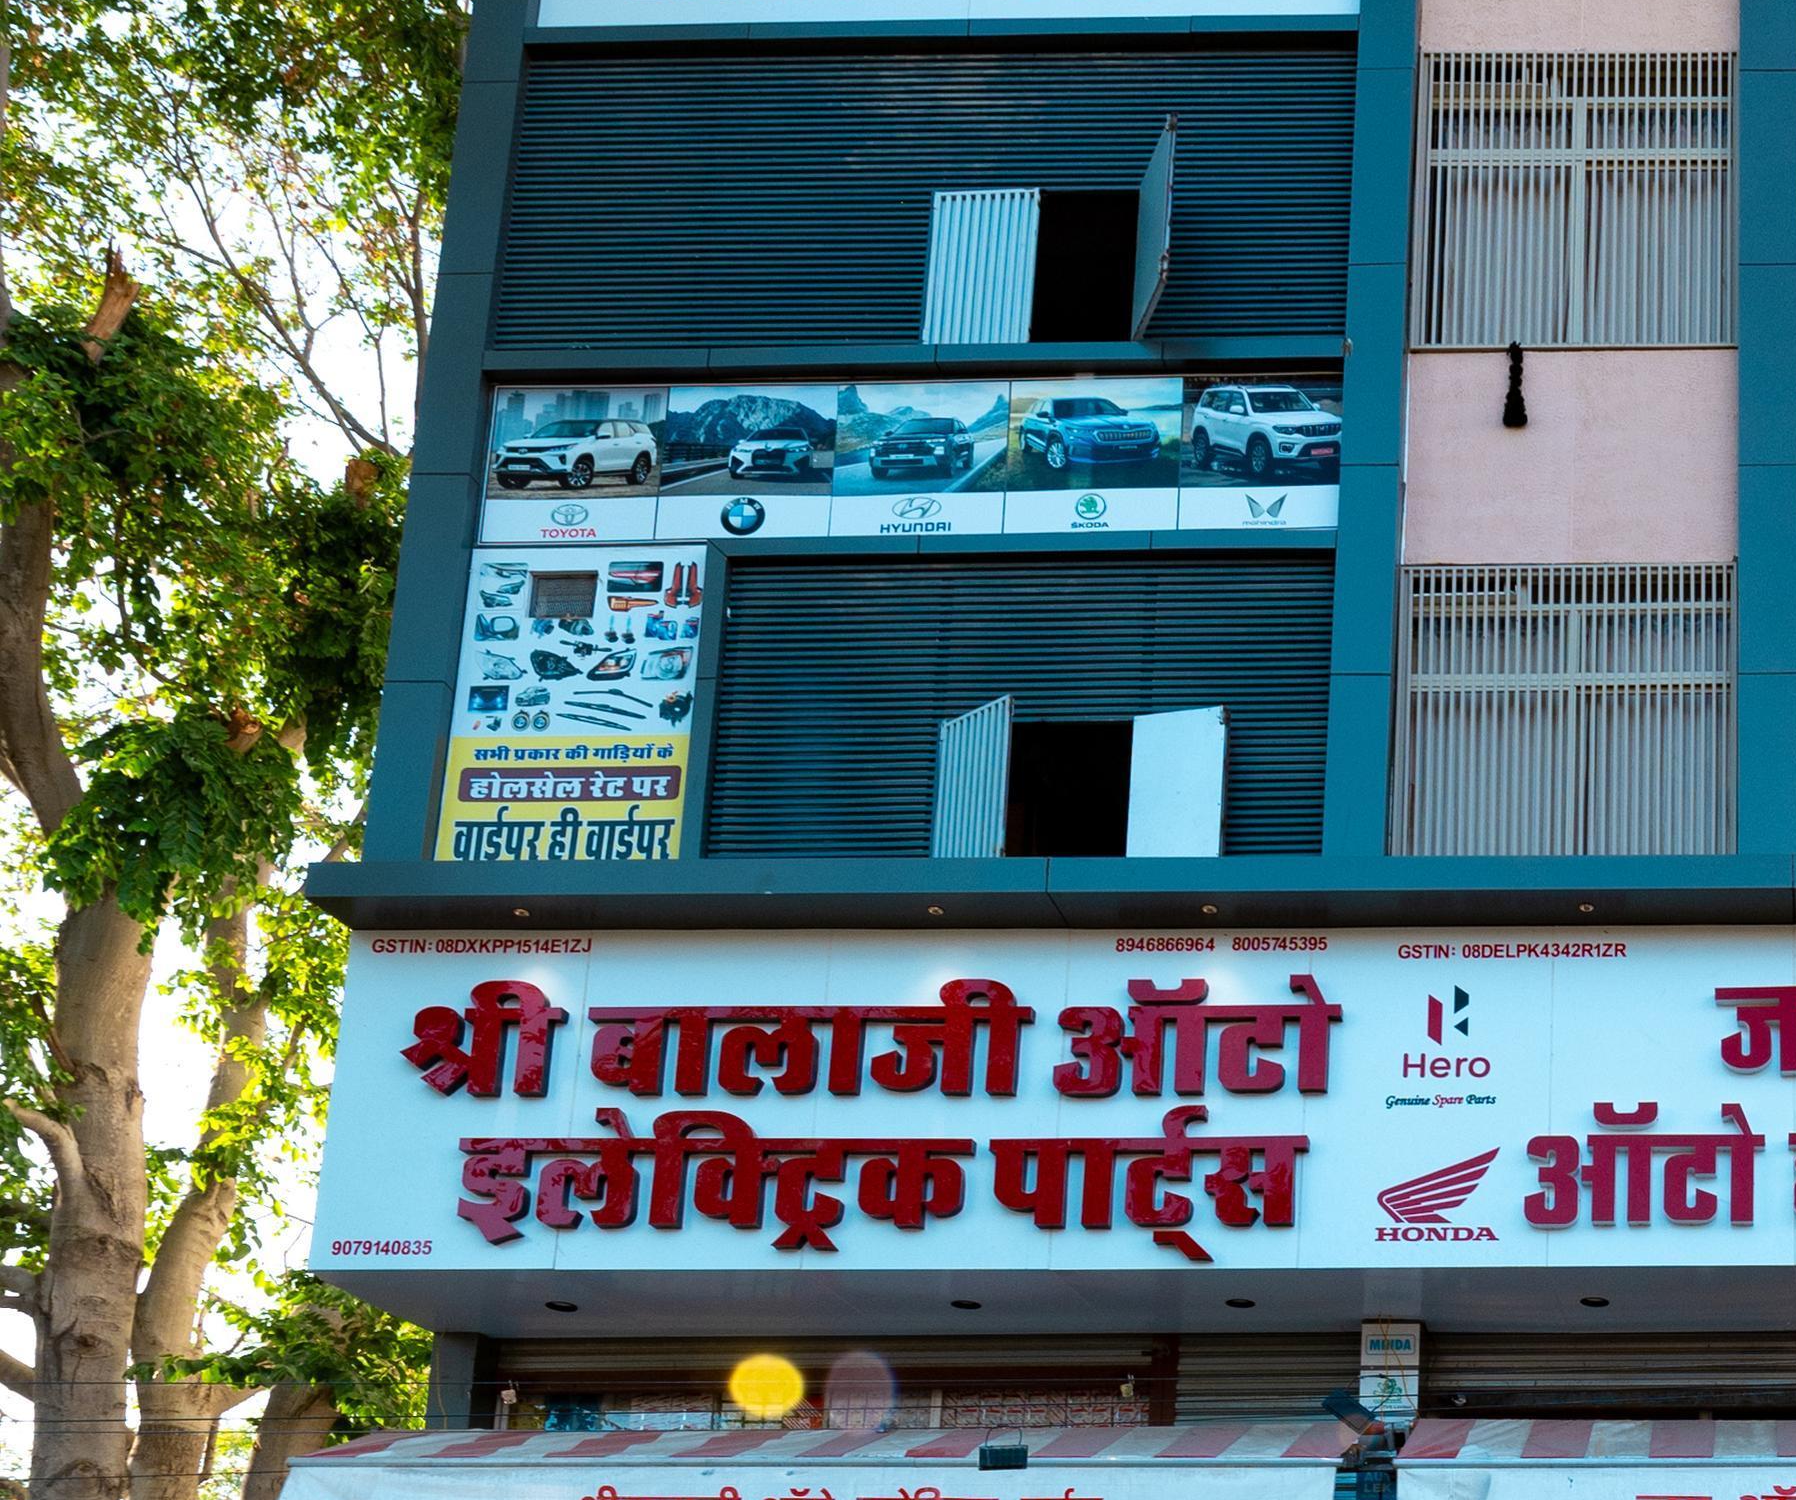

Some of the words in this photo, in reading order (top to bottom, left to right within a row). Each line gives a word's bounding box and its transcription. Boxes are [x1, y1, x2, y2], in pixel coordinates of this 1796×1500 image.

[540, 527, 597, 539] TOYOTA
[880, 521, 952, 534] HYUNDAI
[474, 745, 512, 761] सभी
[514, 748, 562, 762] प्रकार
[564, 744, 590, 760] की
[592, 743, 655, 764] गाड़ियों
[656, 743, 674, 759] के
[469, 772, 586, 799] होलसेल
[589, 771, 627, 797] रेट
[631, 776, 672, 797] पर
[453, 806, 546, 861] वाईपर
[549, 807, 583, 861] ही
[585, 804, 676, 860] वाईपर
[372, 938, 433, 953] GSTIN:
[435, 938, 592, 954] 08DXKPP1514E1ZJ
[1115, 937, 1216, 953] 8946866964
[1231, 936, 1328, 951] 8005745395
[1397, 944, 1456, 959] GSTIN:
[1461, 943, 1627, 958] 08DELPK4342R1ZR
[400, 979, 570, 1098] श्री
[588, 978, 1037, 1098] बालाजी
[1052, 973, 1344, 1098] ऑटो
[1402, 1052, 1491, 1078] Hero
[1385, 1094, 1430, 1109] Genuine
[1432, 1094, 1464, 1108] Spare
[1465, 1094, 1496, 1105] Parts
[1523, 1102, 1766, 1231] ऑटो
[989, 1104, 1309, 1262] पार्ट्स
[1374, 1226, 1500, 1242] HONDA
[331, 1240, 433, 1256] 9079140835
